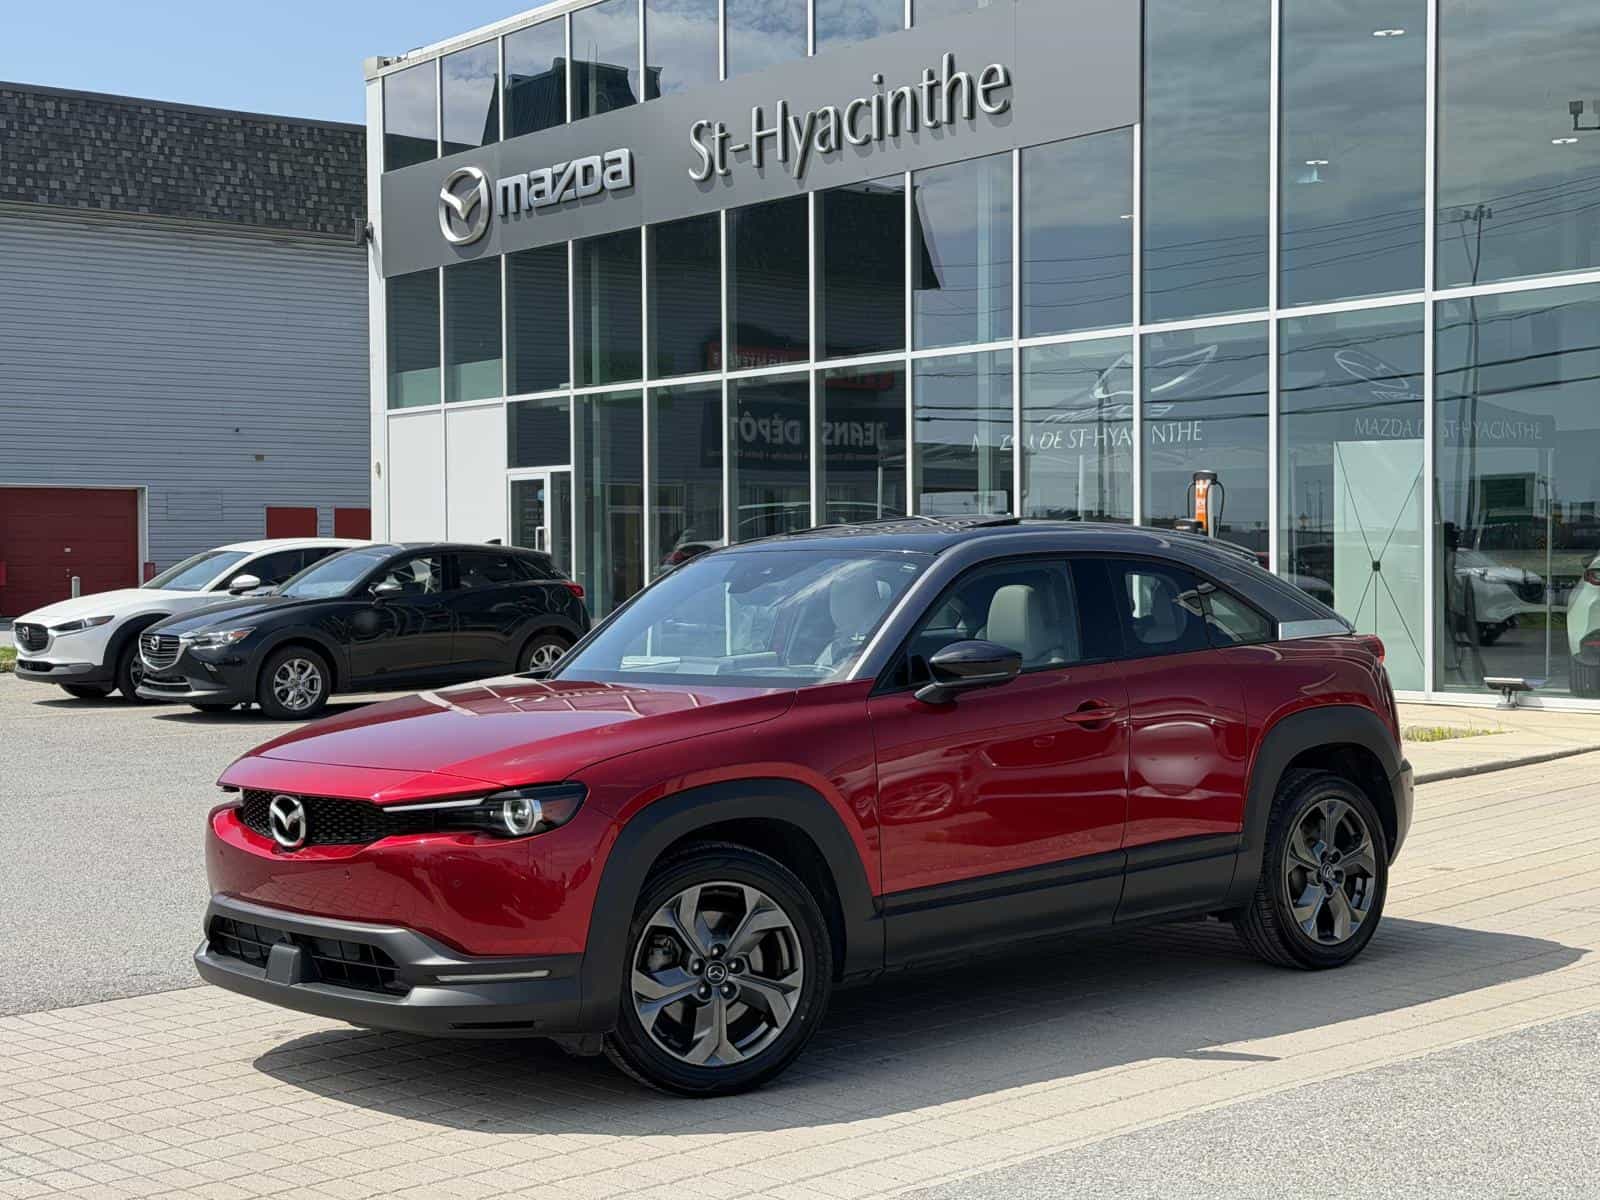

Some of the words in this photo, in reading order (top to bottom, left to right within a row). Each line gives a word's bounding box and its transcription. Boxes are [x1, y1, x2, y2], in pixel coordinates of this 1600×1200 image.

[687, 52, 1012, 182] St-Hyacinthe
[1354, 416, 1416, 438] MAZDA
[1039, 430, 1064, 450] DE
